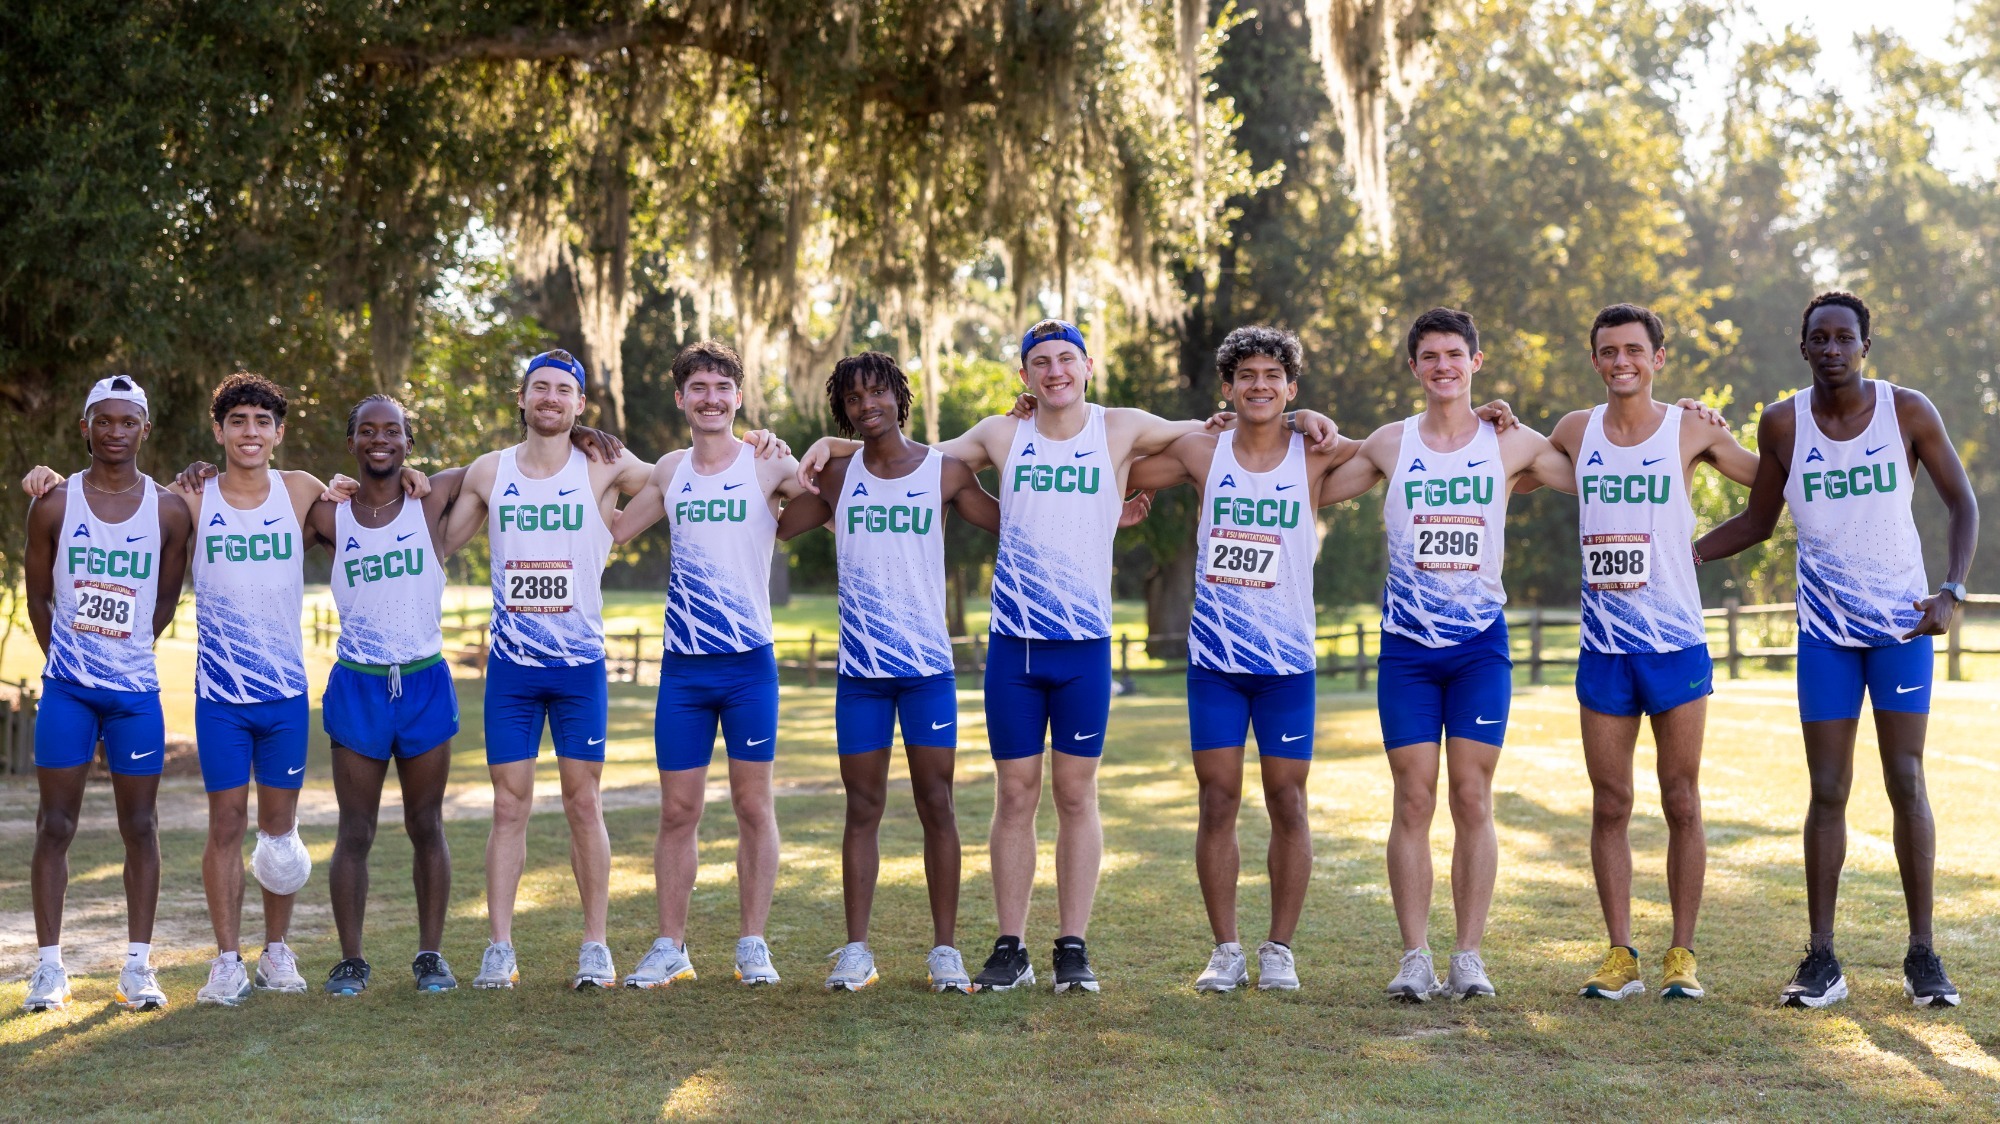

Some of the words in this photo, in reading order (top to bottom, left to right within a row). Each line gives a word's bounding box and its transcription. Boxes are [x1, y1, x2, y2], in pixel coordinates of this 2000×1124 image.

[1014, 465, 1099, 494] FGCU
[1404, 476, 1493, 509] FGCU
[1583, 475, 1670, 504] FGCU
[1803, 462, 1897, 502] FGCU
[499, 504, 583, 532] FGCU
[675, 499, 746, 525] FGCU
[848, 505, 932, 535] FGCU
[1213, 497, 1300, 529] FGCU
[1442, 516, 1480, 525] INVITATIONAL
[206, 533, 292, 563] FGCU
[1238, 533, 1276, 543] INVITATIONAL
[1419, 531, 1478, 556] 2396
[1606, 534, 1644, 542] INVITATIONAL
[69, 547, 152, 579] FGCU
[344, 548, 423, 587] FGCU
[1213, 544, 1274, 573] 2397
[1589, 550, 1644, 576] 2398
[511, 576, 568, 599] 2388
[1216, 576, 1242, 585] FLORIDA
[1245, 579, 1266, 587] STATE
[77, 592, 130, 624] 2393
[73, 622, 100, 632] FLORIDA
[101, 628, 122, 637] STATE
